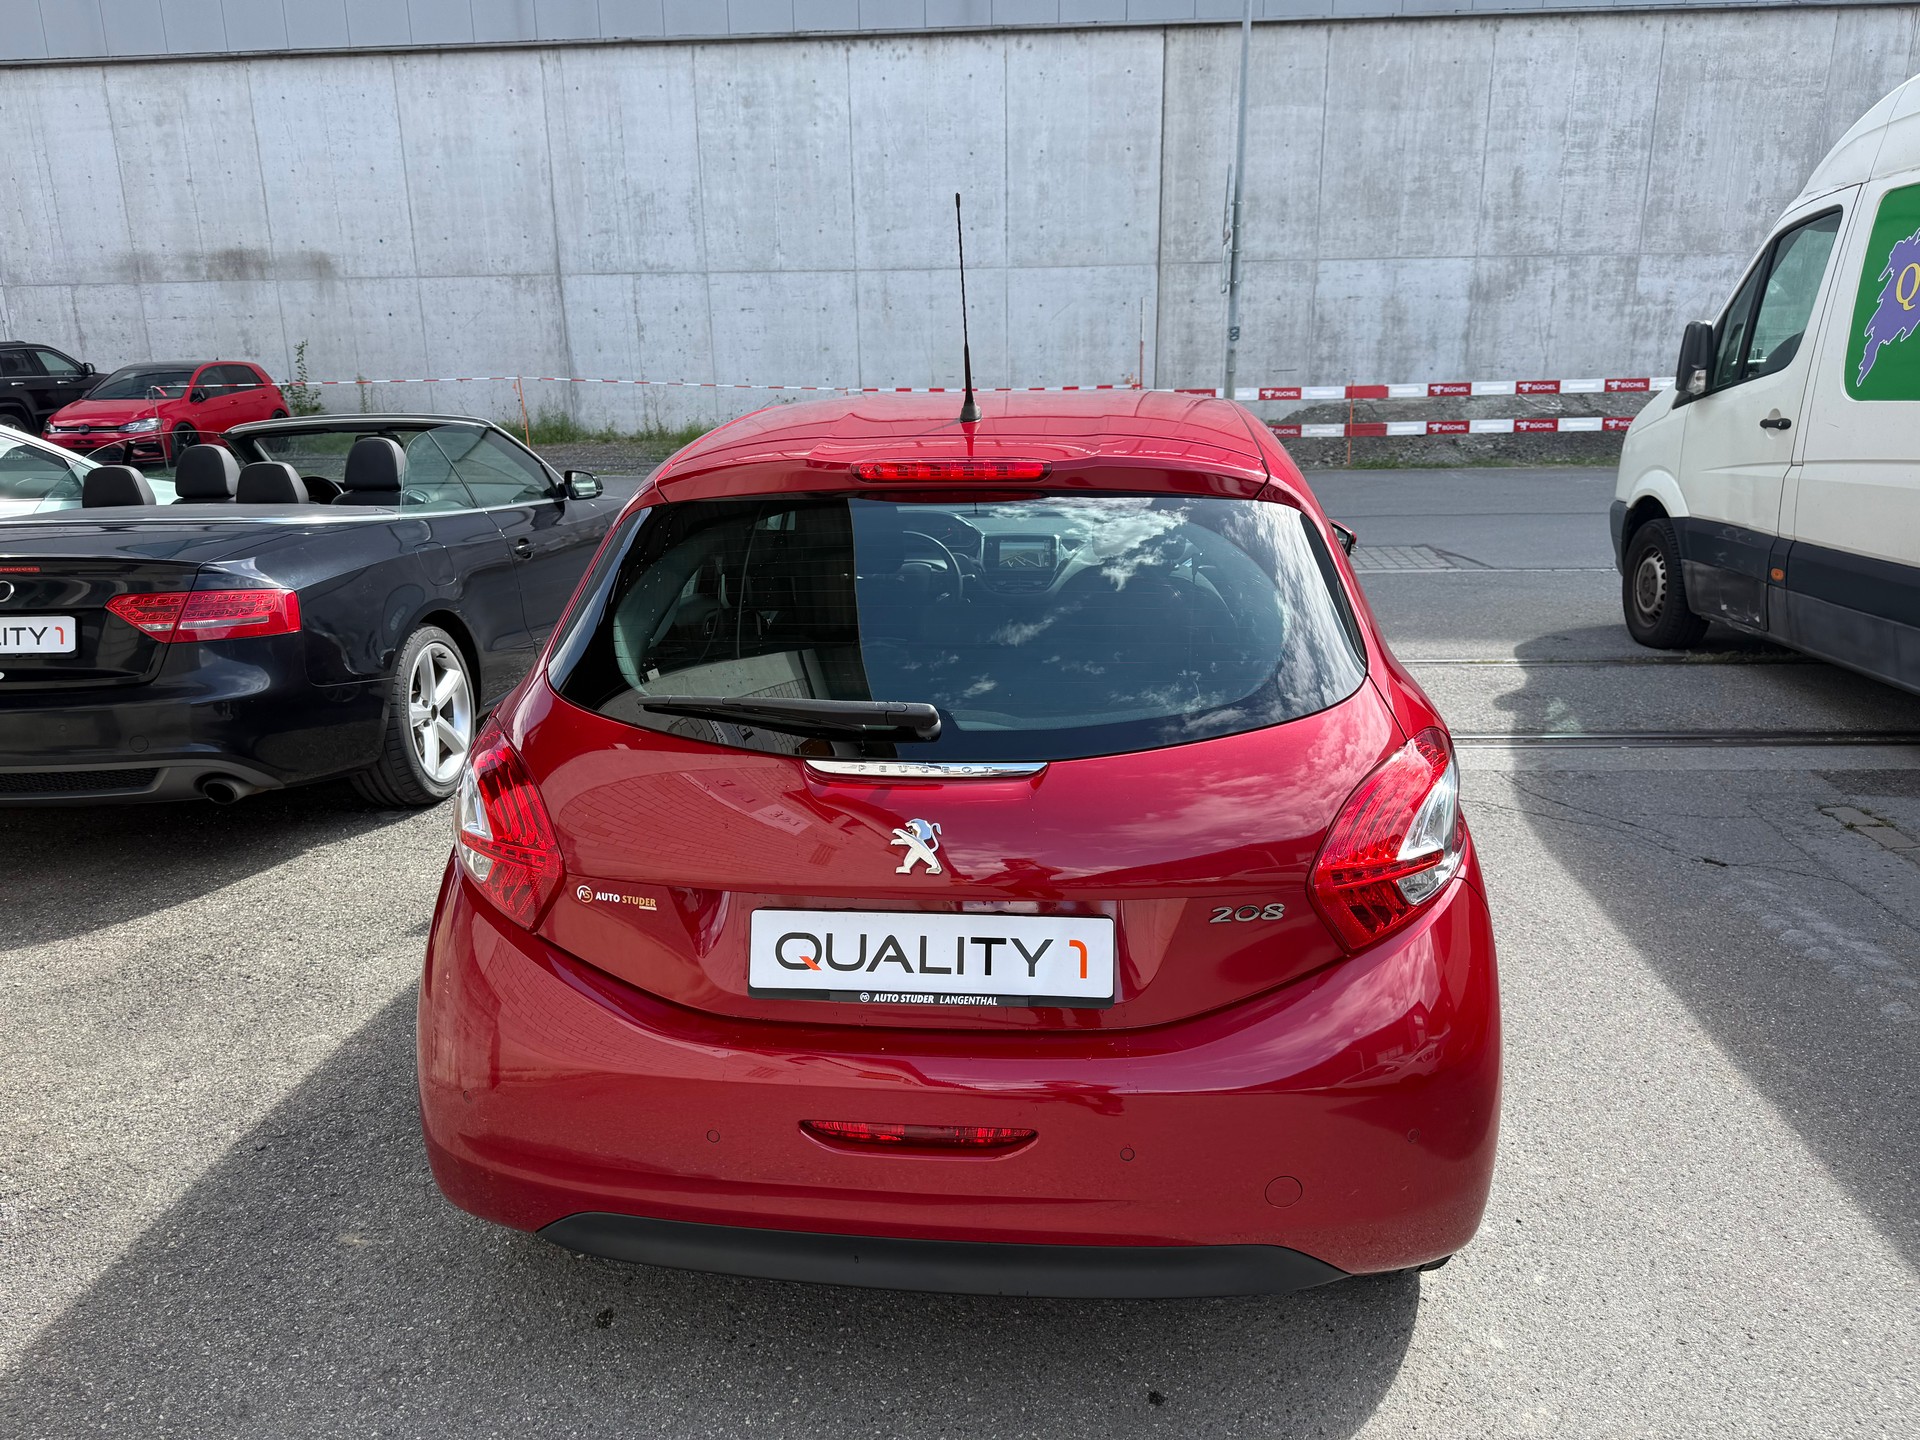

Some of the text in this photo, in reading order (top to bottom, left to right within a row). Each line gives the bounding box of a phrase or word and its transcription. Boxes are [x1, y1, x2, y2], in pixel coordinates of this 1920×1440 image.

[54, 626, 64, 645] 1
[857, 764, 993, 775] PEUGEOT
[595, 891, 620, 903] AUTO
[622, 895, 656, 907] STUDER
[1209, 903, 1285, 923] 208
[775, 931, 1087, 979] QUALITY 1
[873, 993, 899, 1003] AUTO
[901, 994, 934, 1004] STUDER
[939, 995, 998, 1006] LANGENTHAL
